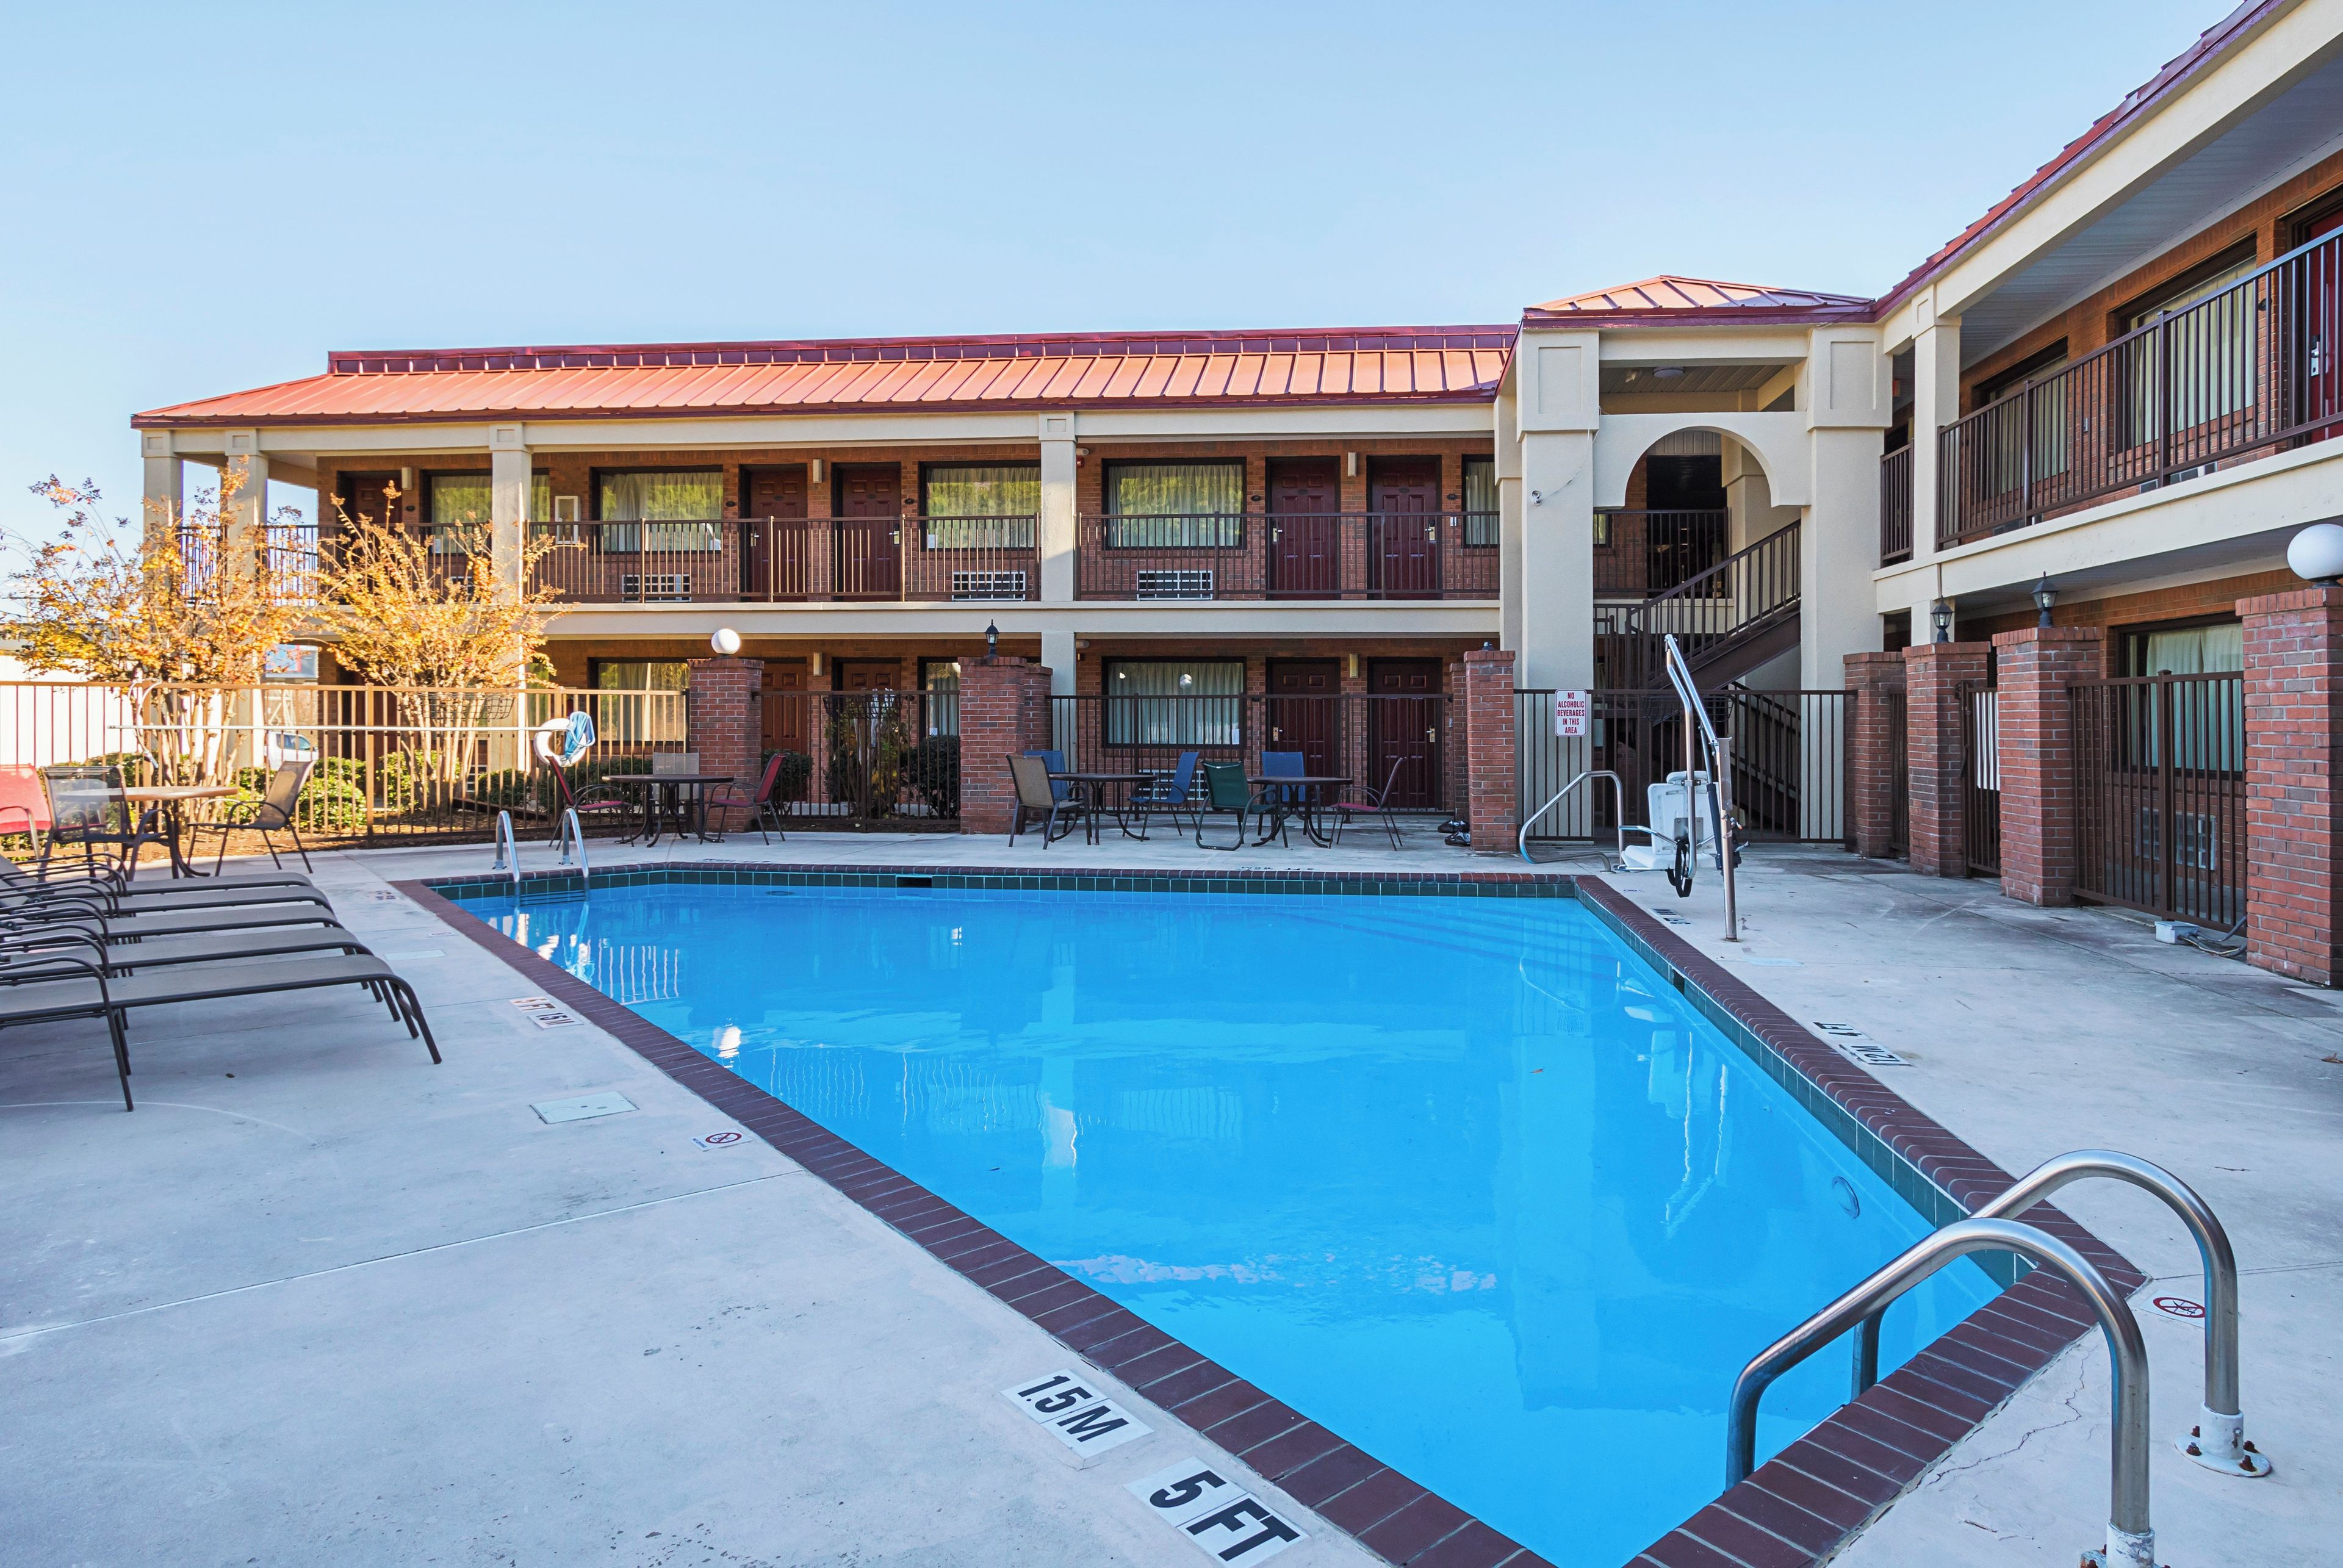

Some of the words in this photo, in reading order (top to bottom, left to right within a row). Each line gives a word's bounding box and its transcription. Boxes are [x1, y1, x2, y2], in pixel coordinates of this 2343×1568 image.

[518, 1003, 556, 1012] FT
[1813, 1021, 1854, 1030] FT
[1150, 1470, 1228, 1508] 5
[1186, 1498, 1301, 1562] FT
